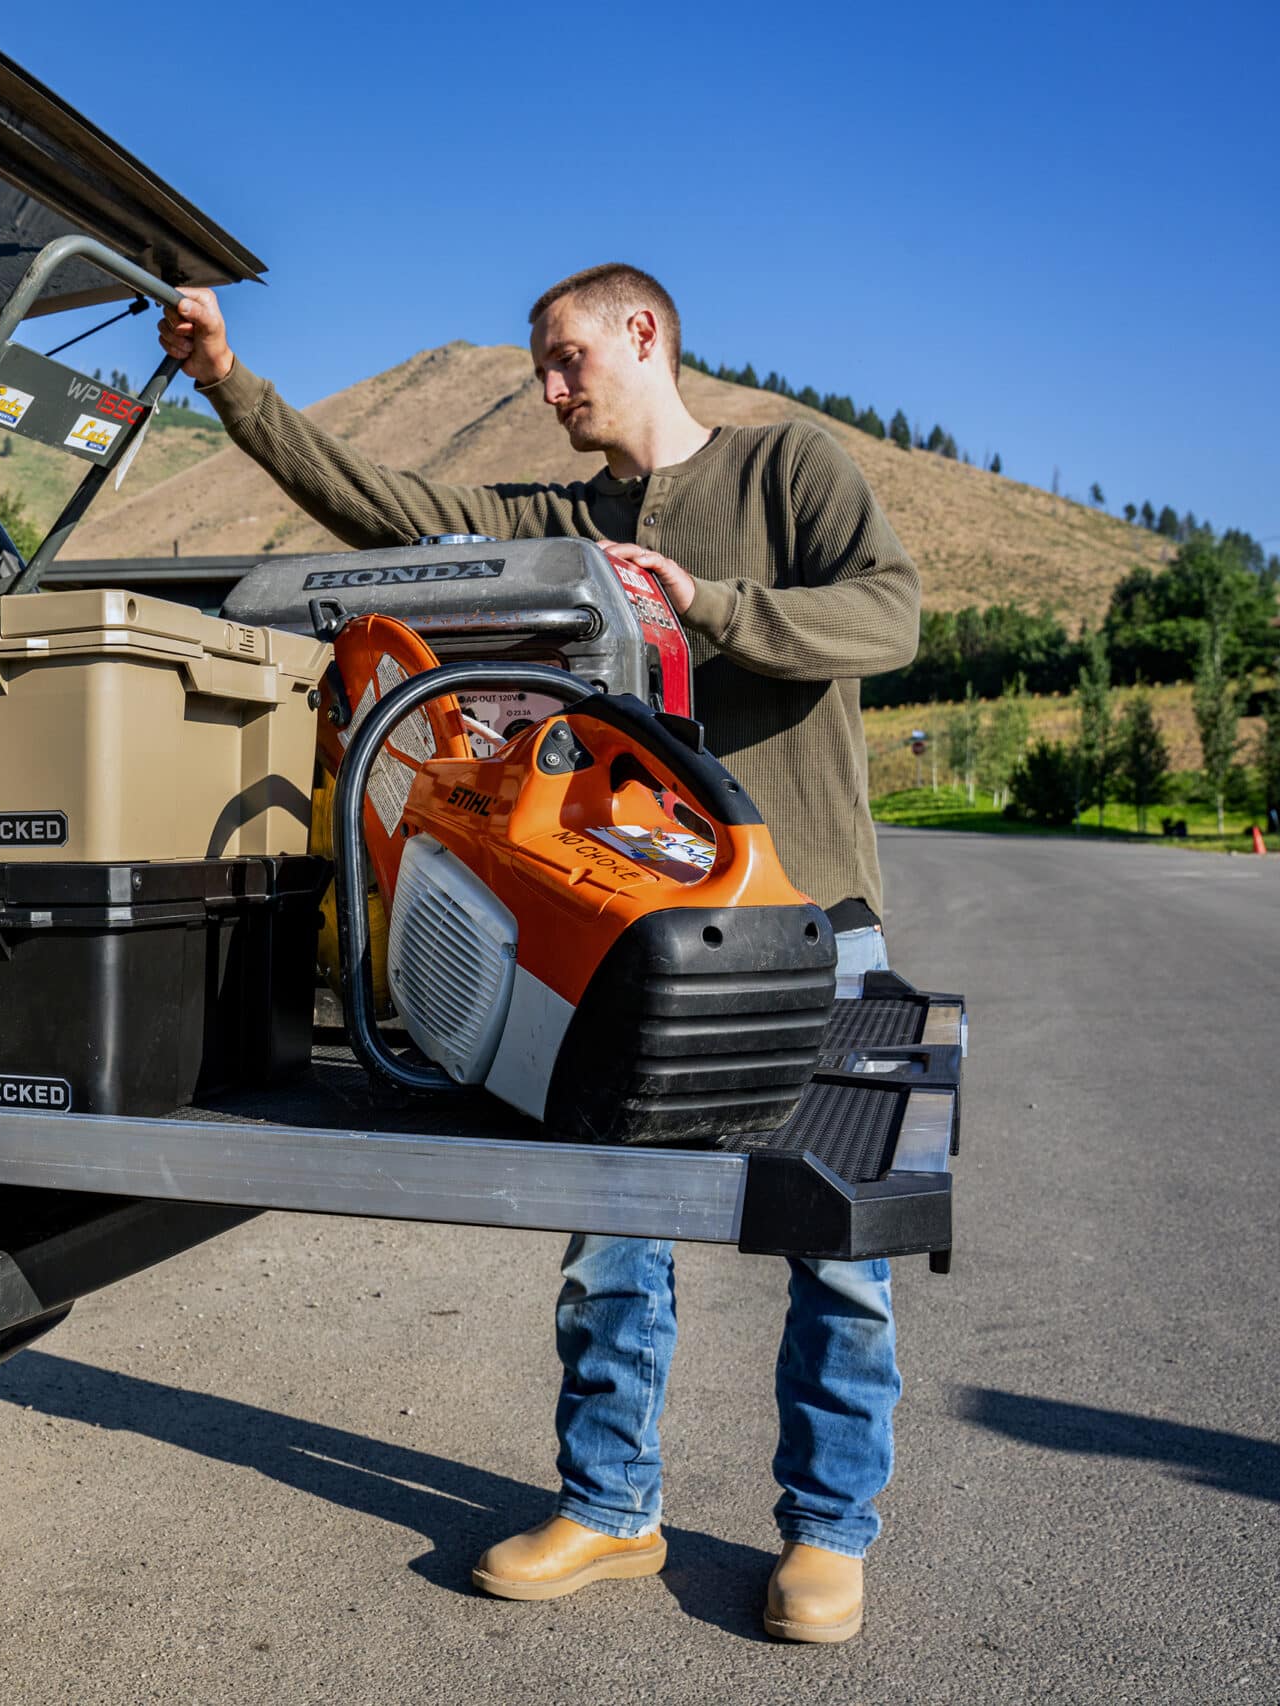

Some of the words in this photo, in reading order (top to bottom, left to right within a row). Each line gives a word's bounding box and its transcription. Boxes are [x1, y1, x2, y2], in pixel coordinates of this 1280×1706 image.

[71, 420, 111, 446] Lutz
[307, 561, 499, 589] HONDA
[499, 694, 518, 702] 120V
[448, 786, 491, 817] STIHL
[552, 831, 584, 846] NO
[575, 846, 641, 880] CHOKE
